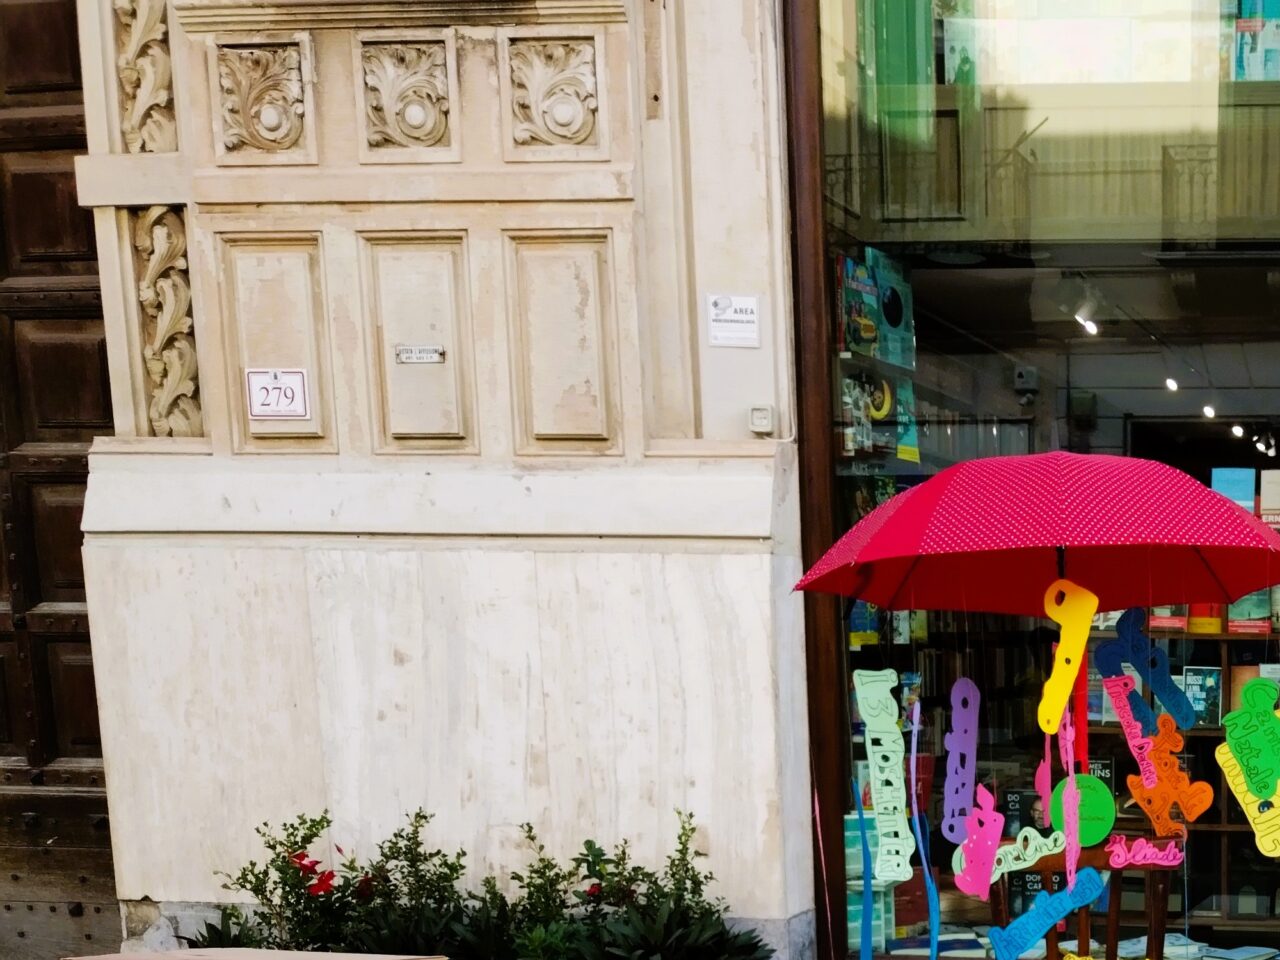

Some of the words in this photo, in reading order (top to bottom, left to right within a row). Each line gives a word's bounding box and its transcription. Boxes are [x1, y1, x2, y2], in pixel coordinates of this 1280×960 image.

[734, 307, 755, 315] AREA
[259, 386, 295, 407] 279
[1223, 711, 1275, 793] Natale
